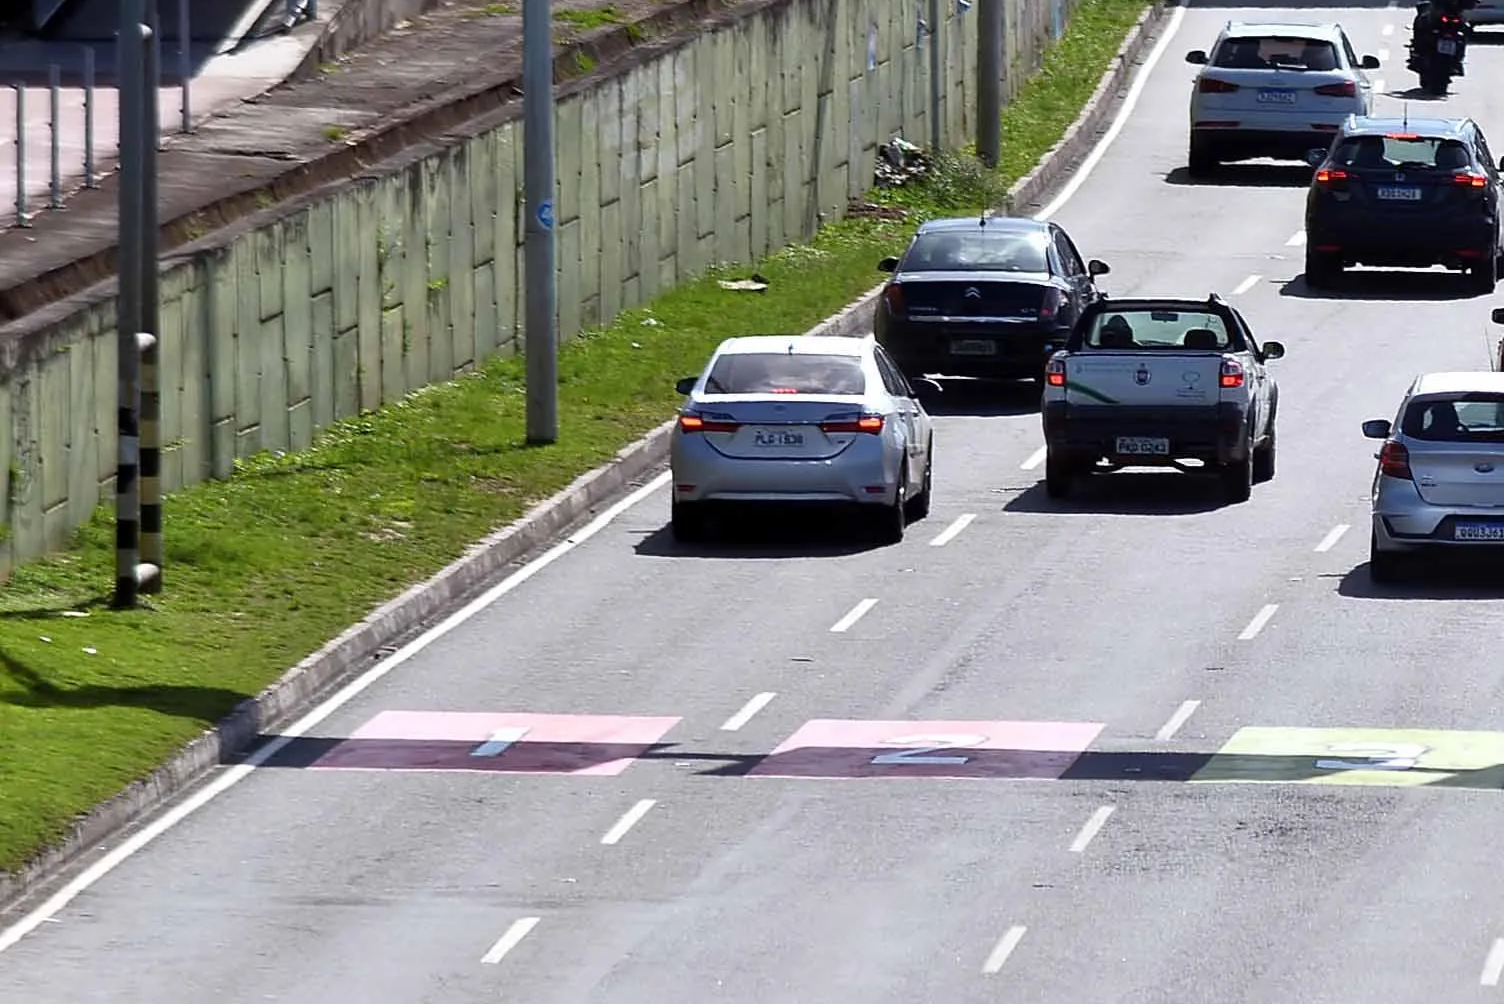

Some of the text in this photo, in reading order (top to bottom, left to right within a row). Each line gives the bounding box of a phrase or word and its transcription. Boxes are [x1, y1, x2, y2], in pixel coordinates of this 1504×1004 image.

[471, 726, 531, 757] 1
[871, 733, 989, 765] 2
[1316, 743, 1429, 770] 3
